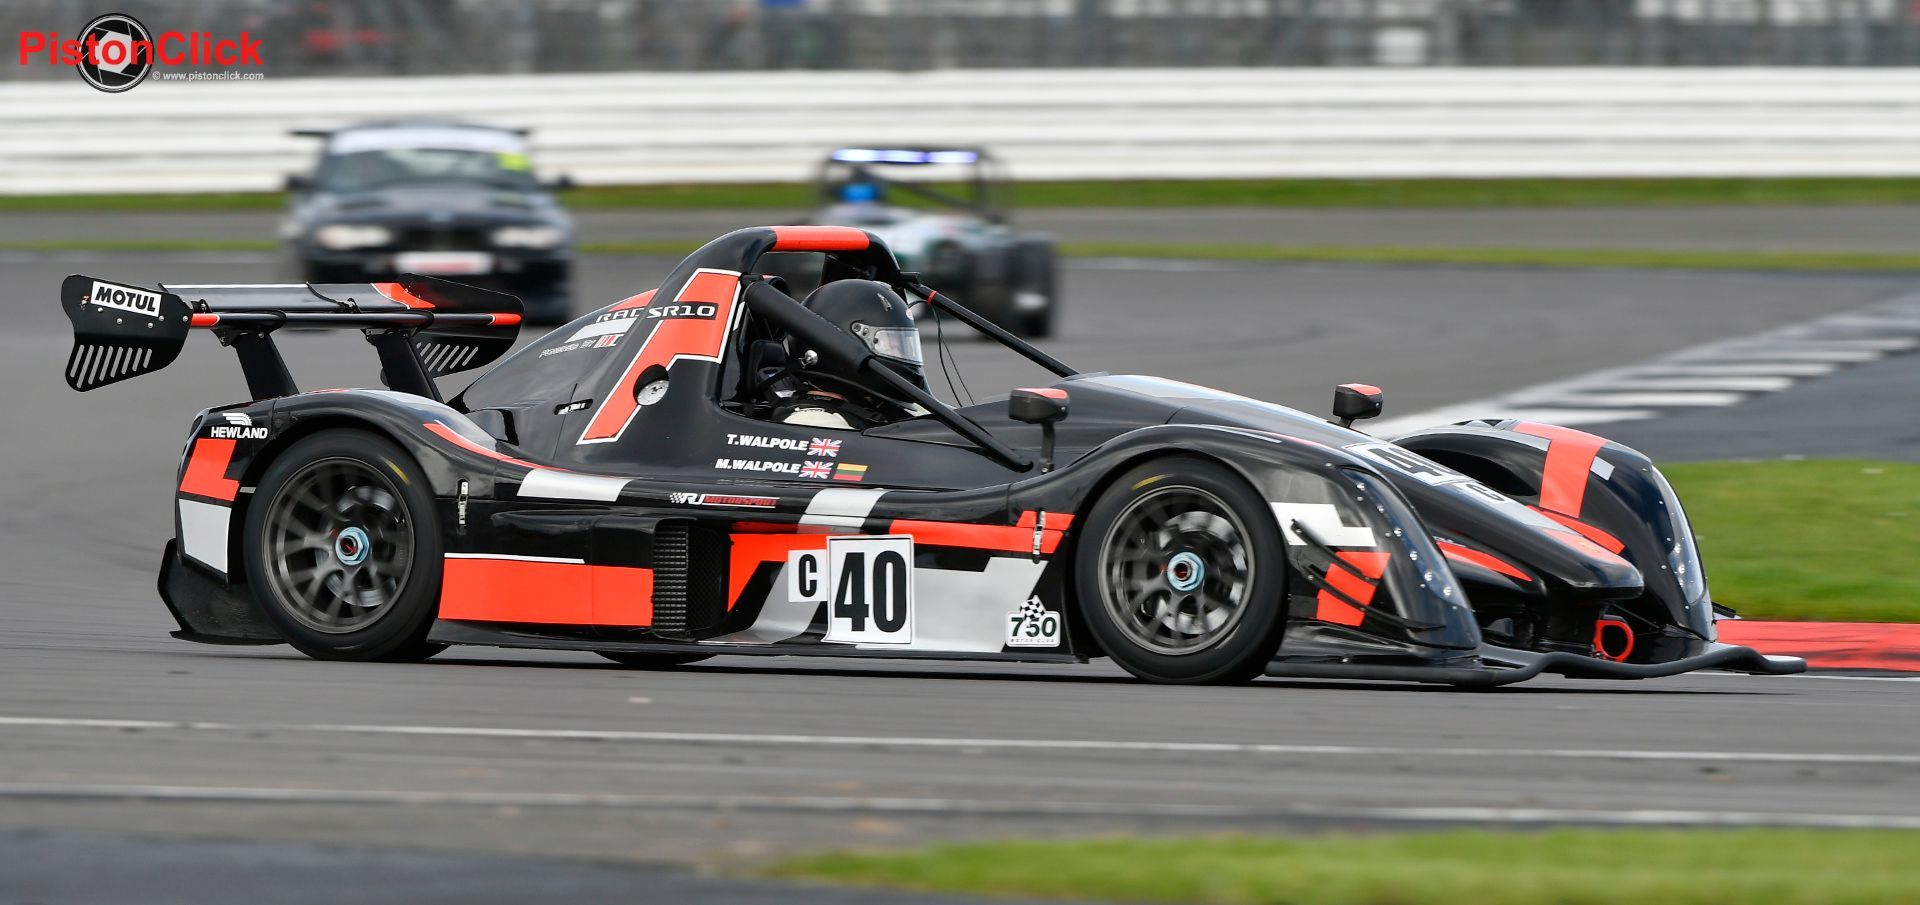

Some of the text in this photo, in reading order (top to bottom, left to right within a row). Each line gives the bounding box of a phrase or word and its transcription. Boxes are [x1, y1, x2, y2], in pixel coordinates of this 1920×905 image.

[95, 287, 156, 312] MOTUL
[647, 305, 716, 319] SR10
[211, 427, 268, 439] HEWLAND
[727, 434, 809, 451] T.WALPOLE
[715, 459, 801, 473] M.WALPOLE
[798, 554, 817, 597] C
[834, 551, 907, 632] 40
[1010, 617, 1057, 637] 750
